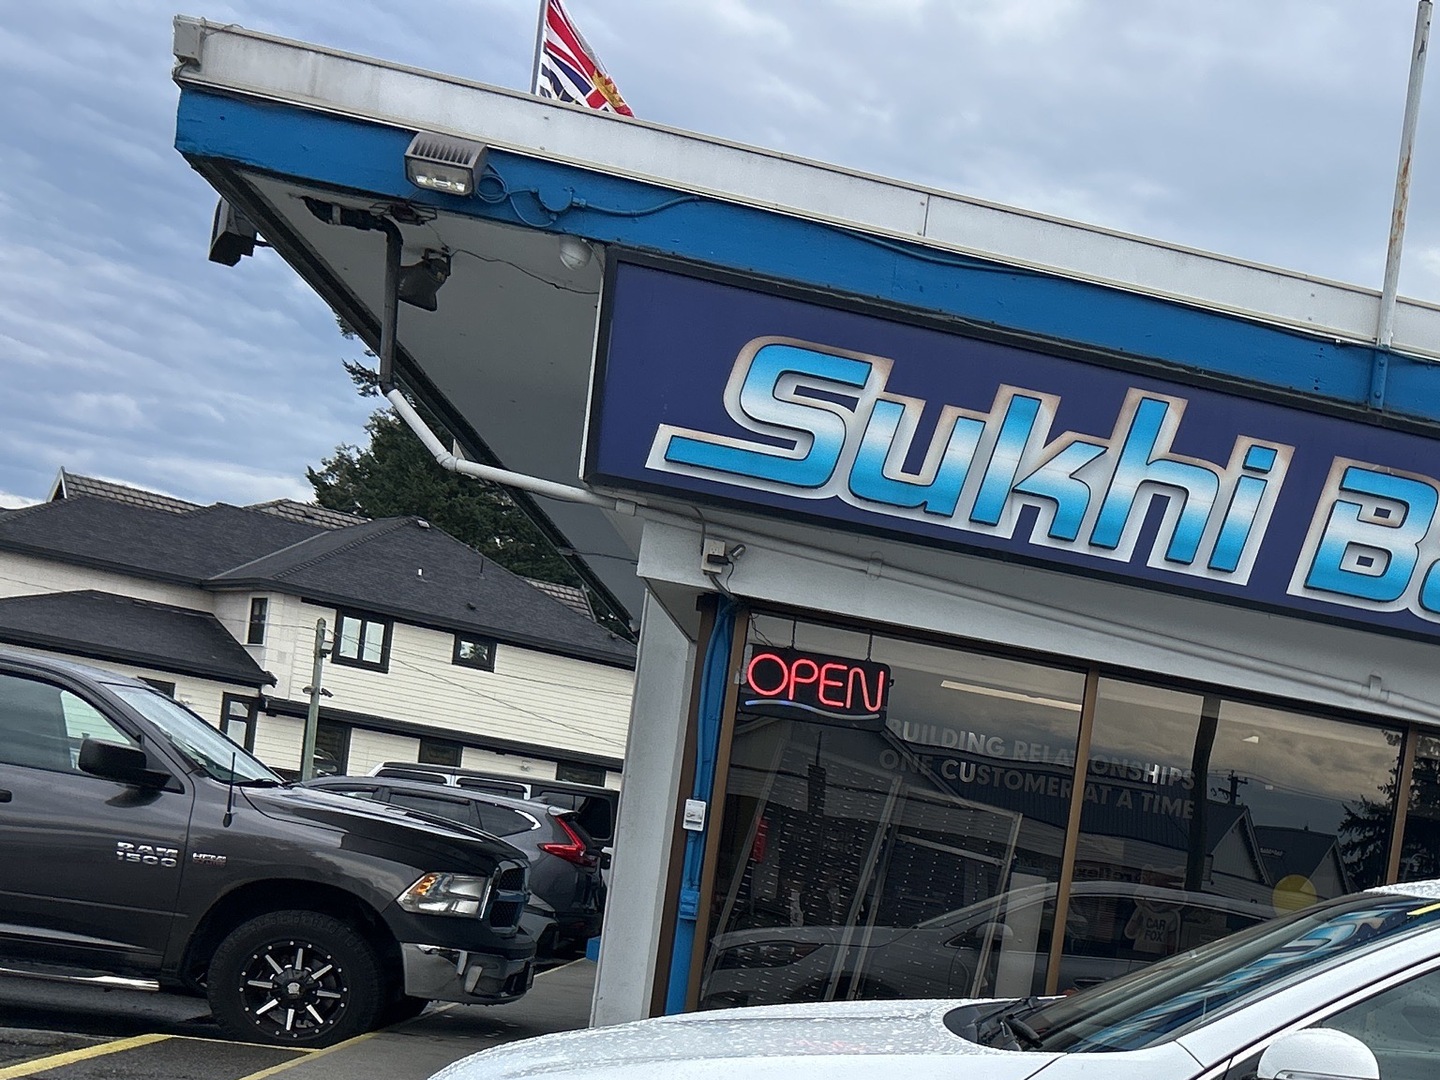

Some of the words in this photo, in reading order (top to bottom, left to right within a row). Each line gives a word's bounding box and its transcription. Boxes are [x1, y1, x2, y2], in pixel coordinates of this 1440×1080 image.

[646, 336, 1294, 586] Sukhi
[747, 653, 884, 712] OPEN
[1013, 740, 1196, 790] RELAONSHIPS
[879, 749, 933, 777] ONE
[1116, 788, 1133, 809] A
[1141, 792, 1195, 819] TIME
[116, 851, 177, 868] 1500
[117, 842, 178, 858] RAM
[1145, 929, 1164, 943] FOX
[1146, 917, 1166, 932] CAR
